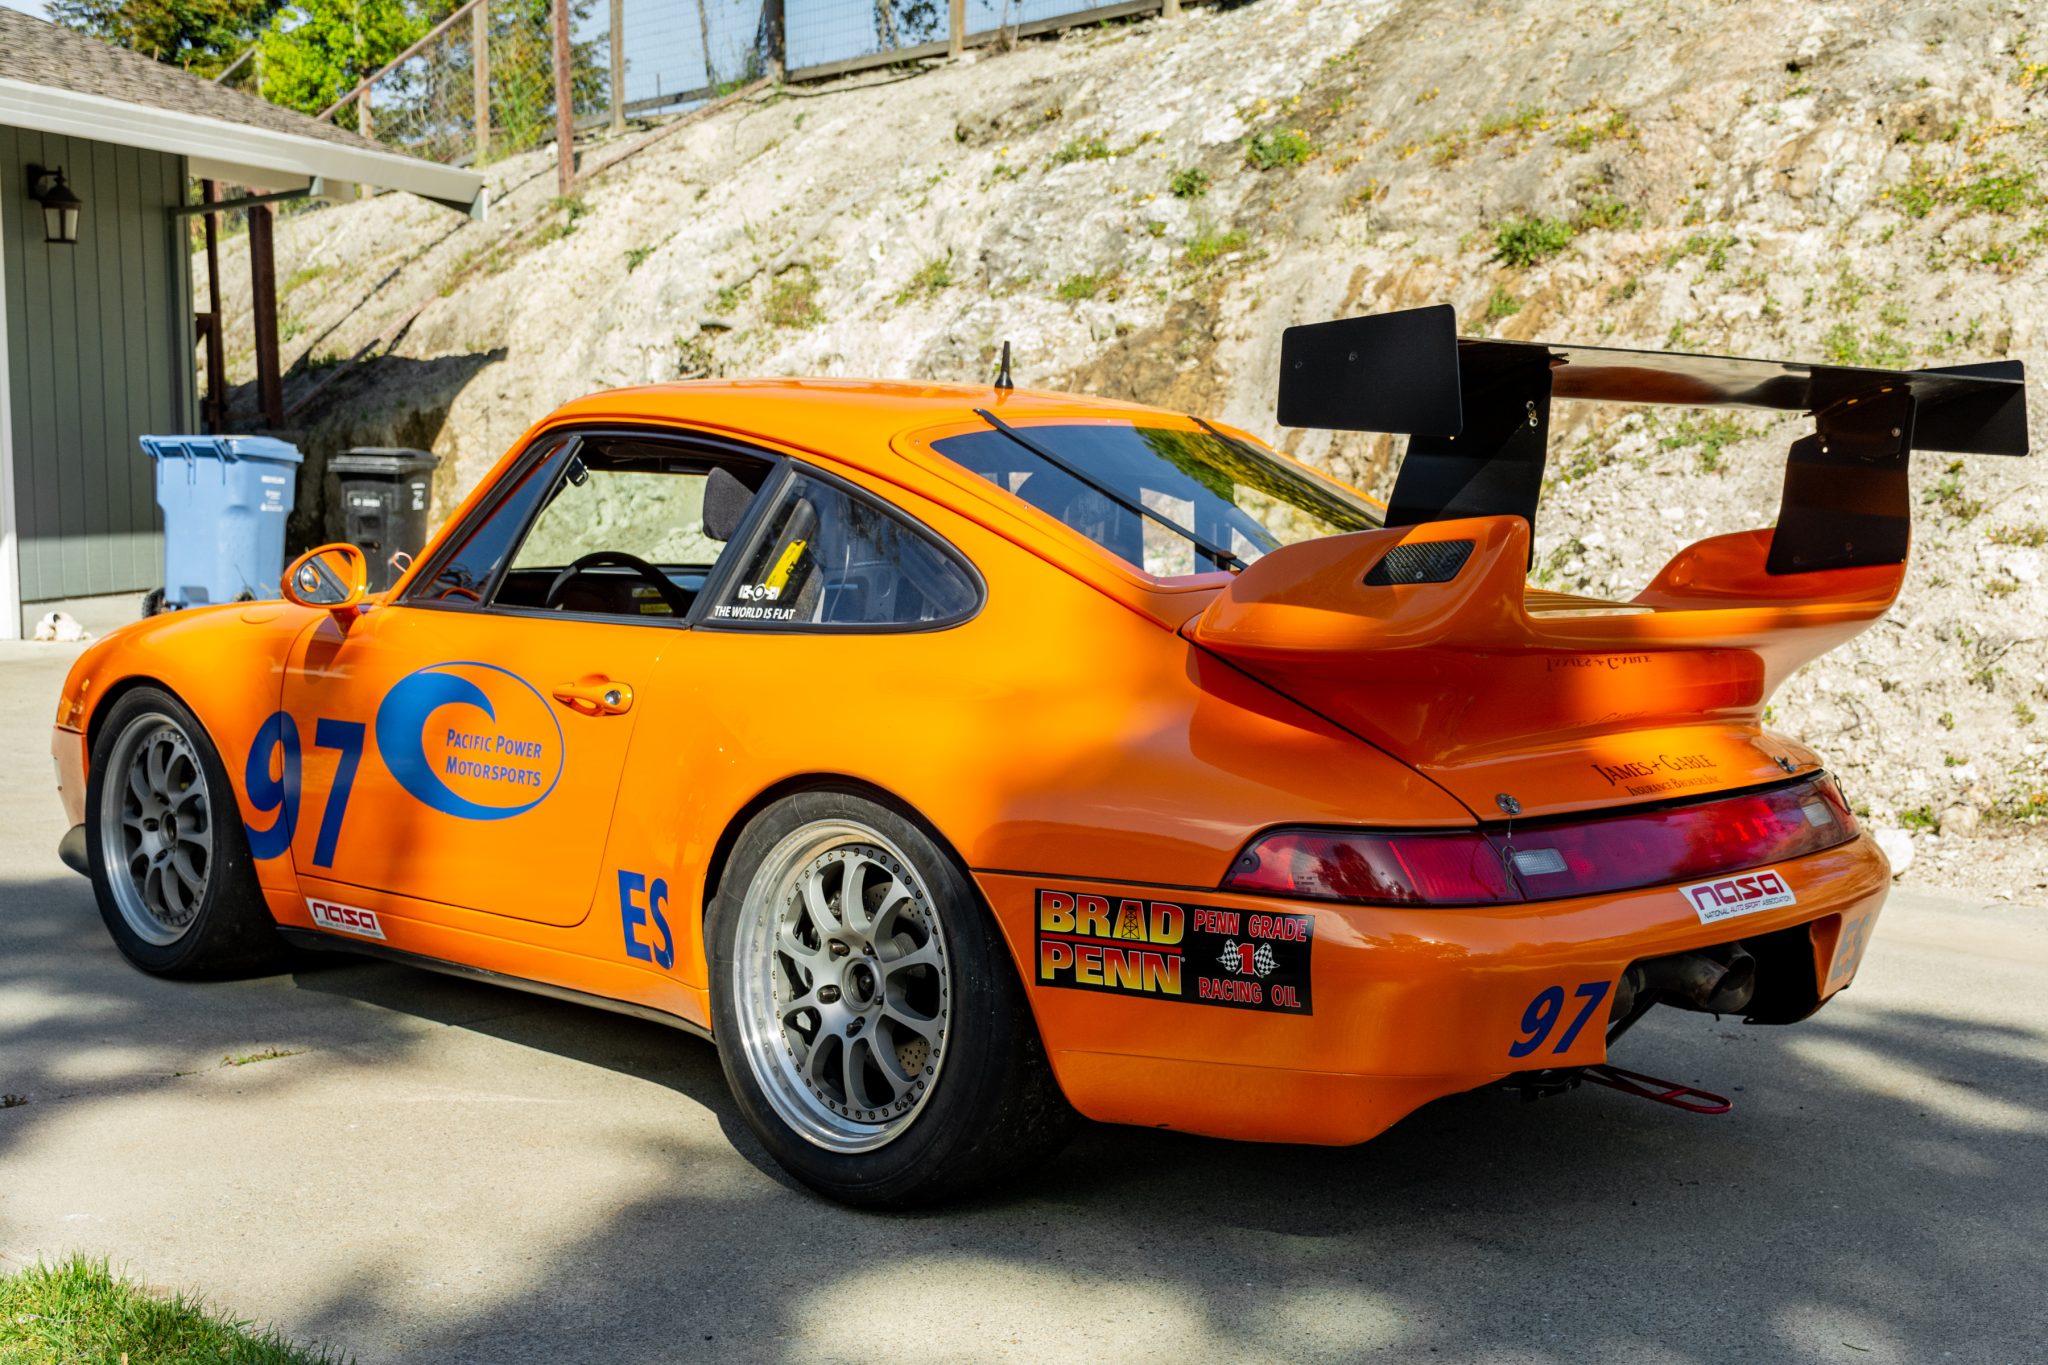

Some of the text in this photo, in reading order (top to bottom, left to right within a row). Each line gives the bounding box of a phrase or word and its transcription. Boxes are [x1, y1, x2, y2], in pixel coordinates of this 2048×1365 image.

[714, 605, 796, 620] THE WORLD IS FLAT
[446, 728, 542, 759] PACIFIC POWER
[446, 755, 542, 787] MOTORSPORTS
[245, 710, 366, 869] 97
[618, 869, 675, 970] ES
[1040, 890, 1185, 945] BRAD
[1194, 909, 1308, 942] PENN GRADE
[1040, 939, 1182, 995] PENN
[1237, 943, 1255, 975] 1
[1199, 977, 1301, 1008] RACING OIL
[1508, 981, 1612, 1058] 97
